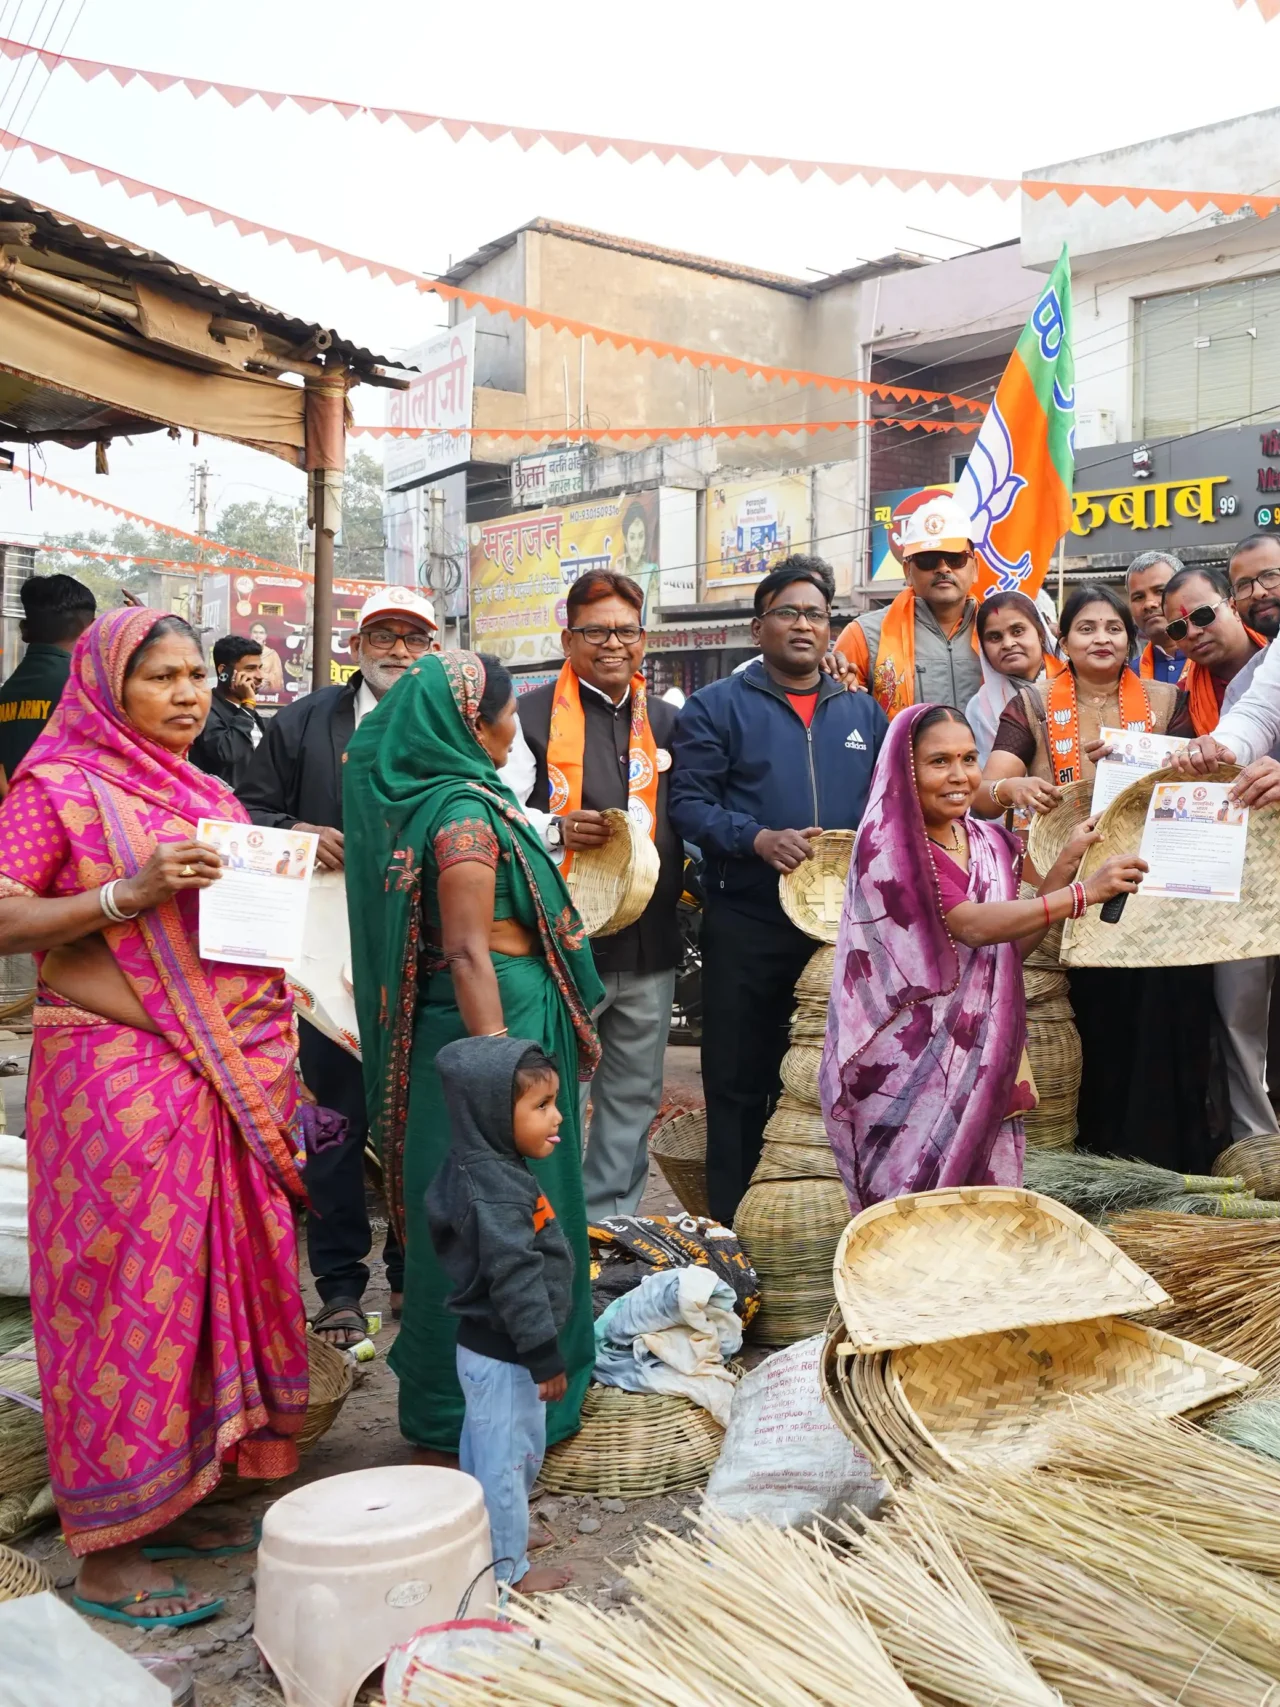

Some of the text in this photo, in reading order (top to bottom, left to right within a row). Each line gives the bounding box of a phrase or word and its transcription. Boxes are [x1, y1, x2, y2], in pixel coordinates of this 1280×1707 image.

[874, 506, 893, 529] न्यू
[482, 515, 564, 573] महाजन
[692, 627, 728, 649] ट्रेडर्स
[17, 699, 52, 720] ARMY
[844, 740, 867, 751] adidas
